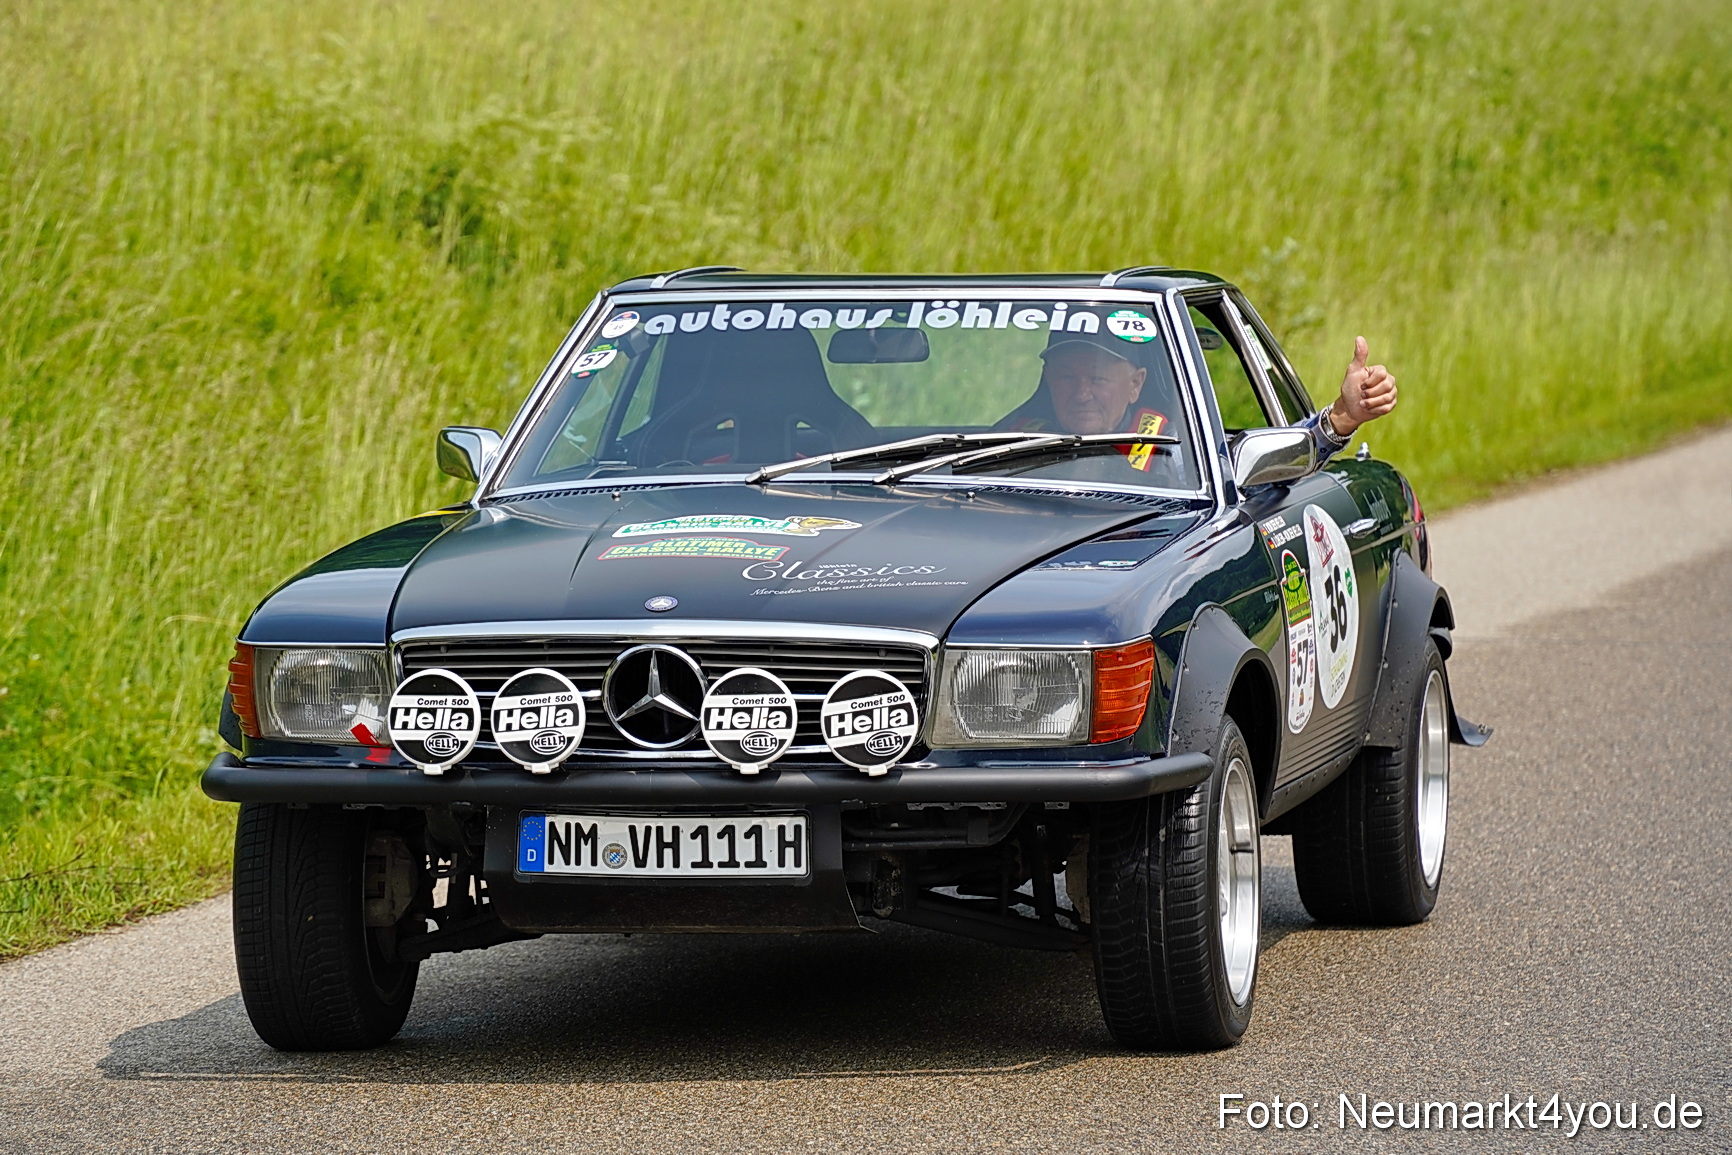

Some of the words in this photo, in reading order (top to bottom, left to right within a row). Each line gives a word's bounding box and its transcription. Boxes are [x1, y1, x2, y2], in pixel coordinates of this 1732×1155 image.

[643, 302, 894, 335] autohaus
[907, 301, 1100, 335] löhlein
[1116, 320, 1146, 331] 78
[580, 351, 610, 367] 57
[652, 540, 747, 548] OLDTIMER
[610, 546, 781, 556] CLASSIC-RALLYE
[742, 561, 947, 581] Classics
[1324, 564, 1348, 653] 36
[1297, 638, 1309, 687] 57
[417, 698, 448, 706] Comet
[451, 698, 469, 706] 500
[519, 697, 551, 706] Comet
[555, 695, 573, 703] 500
[732, 697, 764, 705] Comet
[768, 697, 787, 705] 500
[850, 698, 883, 709] Comet
[887, 694, 905, 703] 500
[394, 708, 469, 730] Hella
[497, 706, 574, 731] Hella
[708, 707, 787, 729] Hella
[830, 708, 908, 737] Hella
[428, 738, 460, 749] HELLA
[533, 736, 566, 747] HELLA
[745, 737, 777, 747] HELLA
[869, 736, 902, 748] HELLA
[548, 821, 598, 866] NM
[628, 824, 680, 868] VH
[527, 849, 536, 861] D
